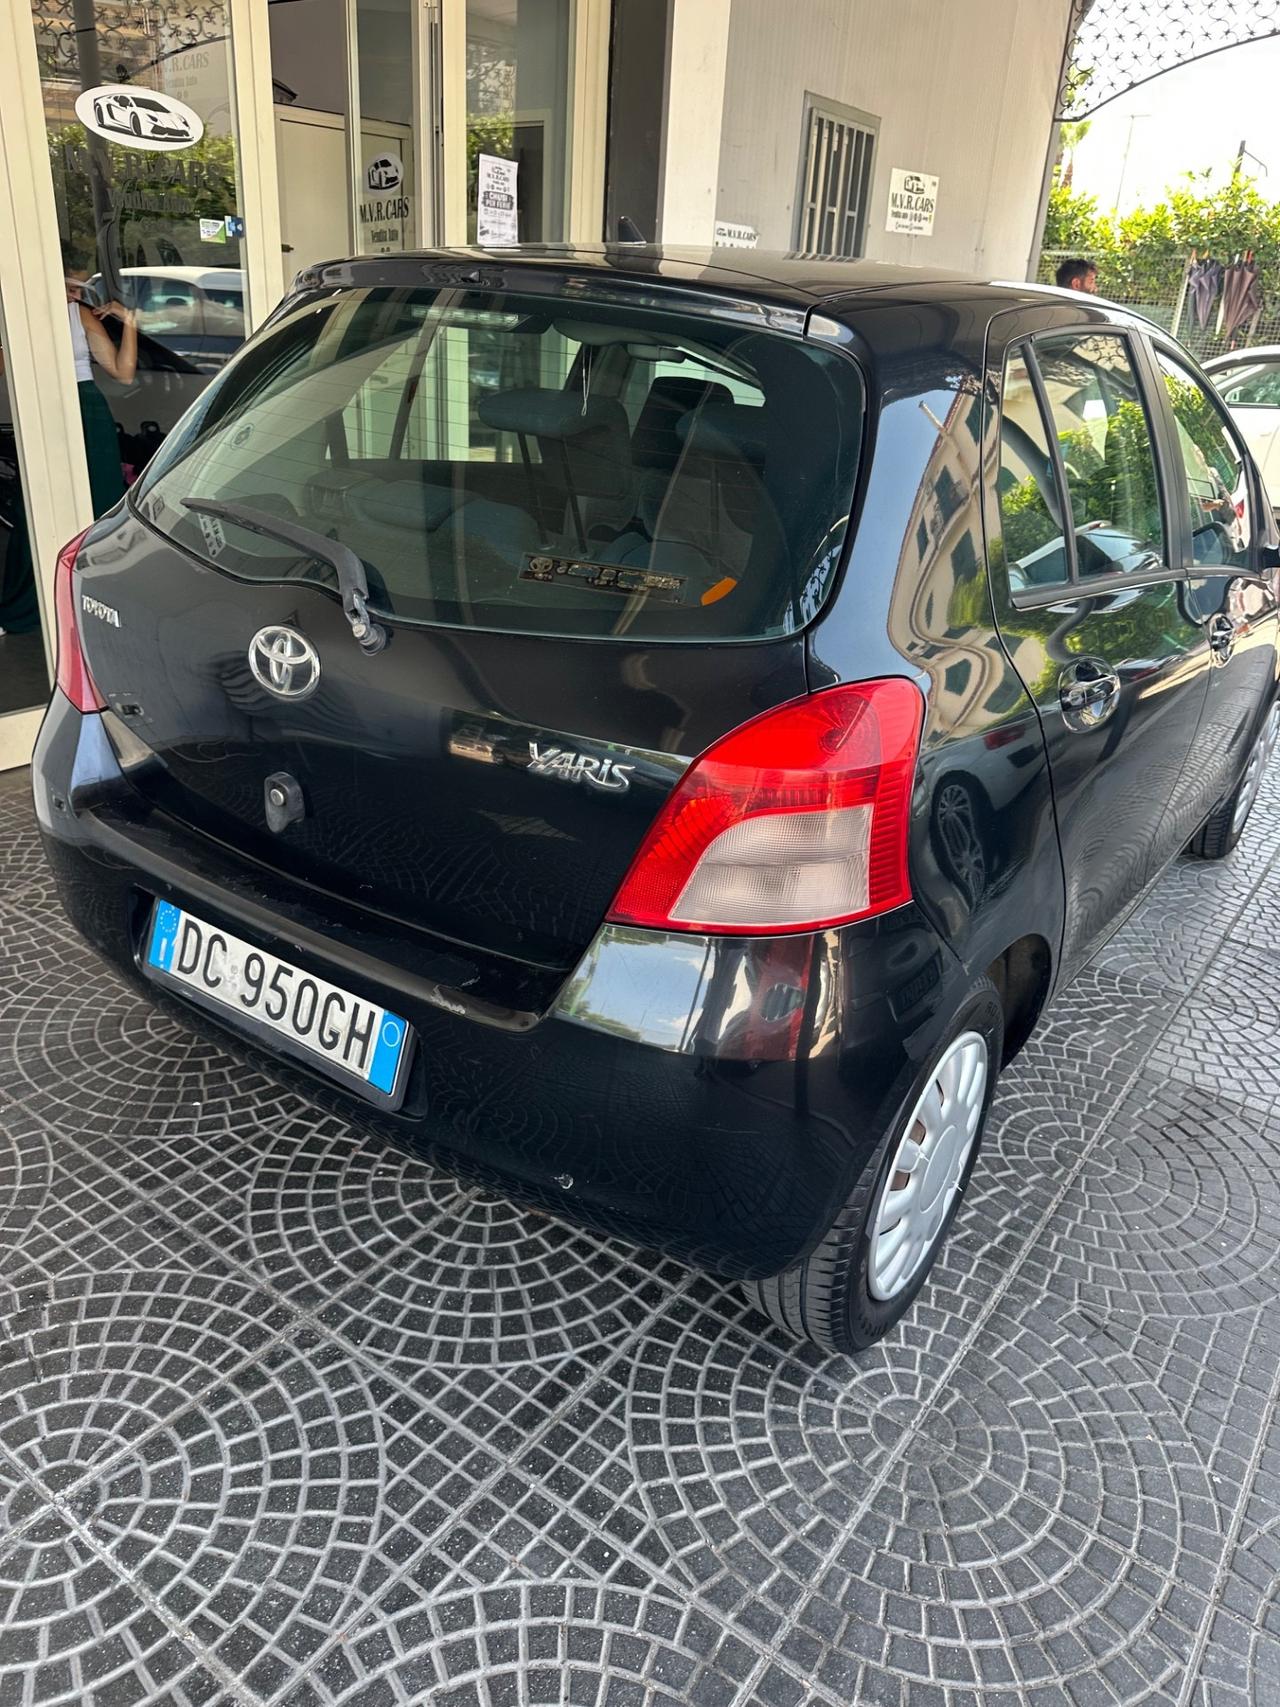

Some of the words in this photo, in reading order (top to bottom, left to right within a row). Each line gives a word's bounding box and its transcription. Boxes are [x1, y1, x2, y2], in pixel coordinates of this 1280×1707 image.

[82, 595, 121, 628] TOYOTA
[177, 918, 227, 988] DC
[240, 953, 376, 1069] 950GH
